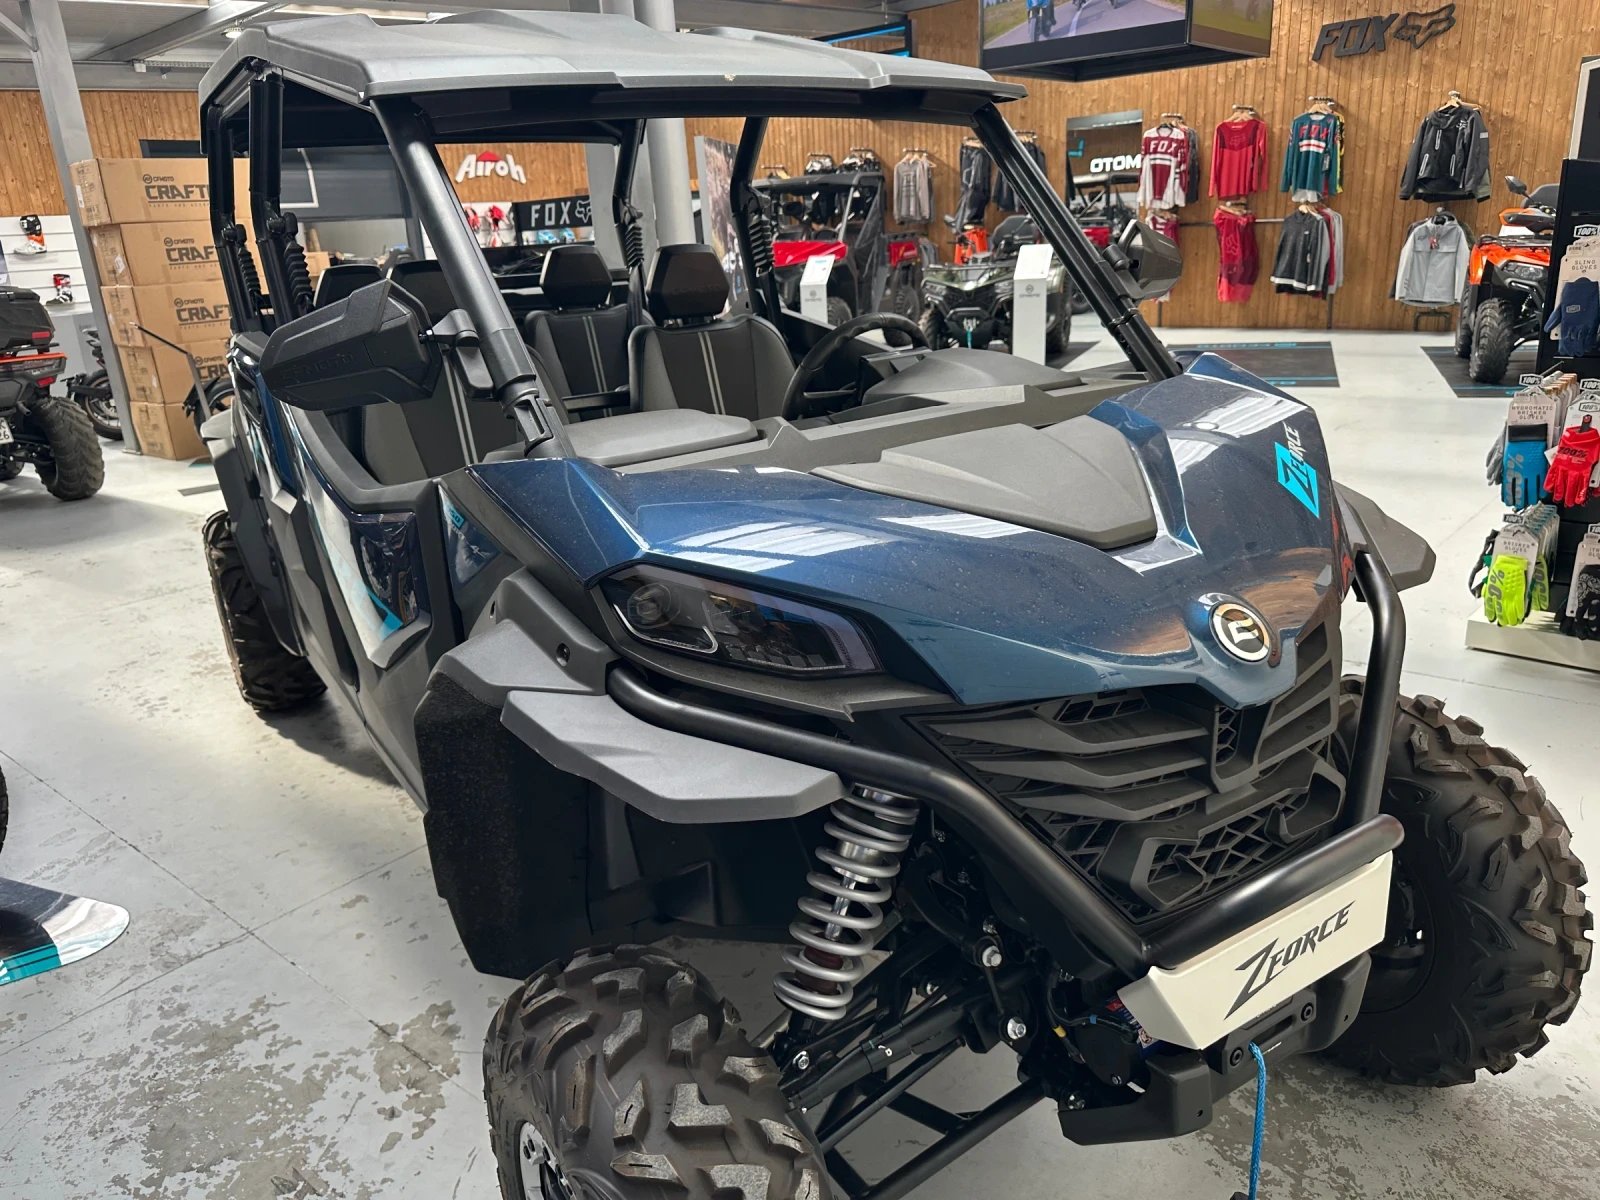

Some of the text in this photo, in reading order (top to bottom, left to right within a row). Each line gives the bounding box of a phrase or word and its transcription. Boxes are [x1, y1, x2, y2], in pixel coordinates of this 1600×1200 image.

[1311, 12, 1400, 62] FOX
[1298, 123, 1331, 140] FOX
[1149, 140, 1178, 153] FOX
[454, 151, 527, 184] Airoh
[144, 184, 210, 200] CRAFT
[530, 201, 571, 227] FOX
[1577, 227, 1597, 236] 100%
[1522, 376, 1541, 384] 100%
[1222, 899, 1357, 1021] ZFORCE
